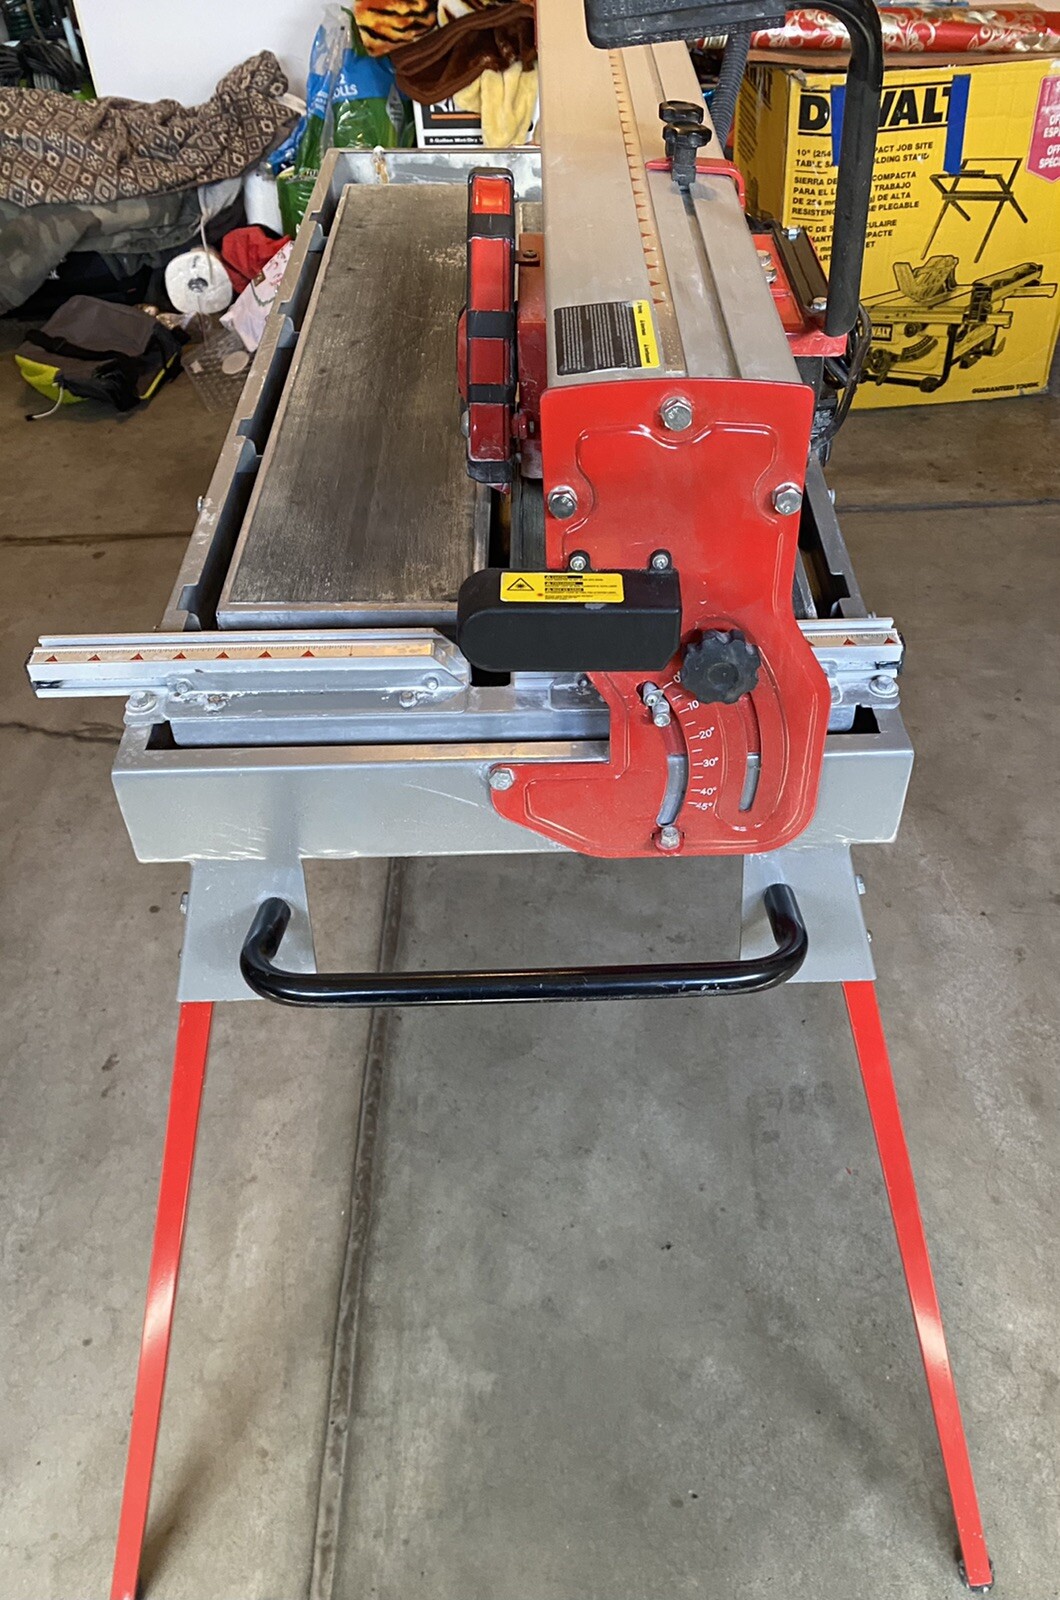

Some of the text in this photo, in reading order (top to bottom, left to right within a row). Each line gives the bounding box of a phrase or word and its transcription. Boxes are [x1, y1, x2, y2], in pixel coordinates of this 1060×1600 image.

[333, 84, 358, 99] OLLS
[896, 143, 912, 152] JOB
[915, 142, 933, 150] SITE
[825, 160, 834, 168] SA
[873, 155, 900, 164] LDING
[794, 176, 824, 185] SIERRA
[793, 187, 815, 195] PARA
[874, 182, 911, 191] TRABAJO
[793, 197, 804, 205] DE
[890, 192, 911, 200] ALTA
[792, 207, 835, 216] RESISTENC
[878, 201, 919, 211] PLEGABLE
[867, 219, 897, 228] ULAIRE
[866, 229, 893, 238] PACTE
[699, 726, 715, 739] 20°
[703, 756, 719, 768] 30°
[700, 786, 717, 796] 40°
